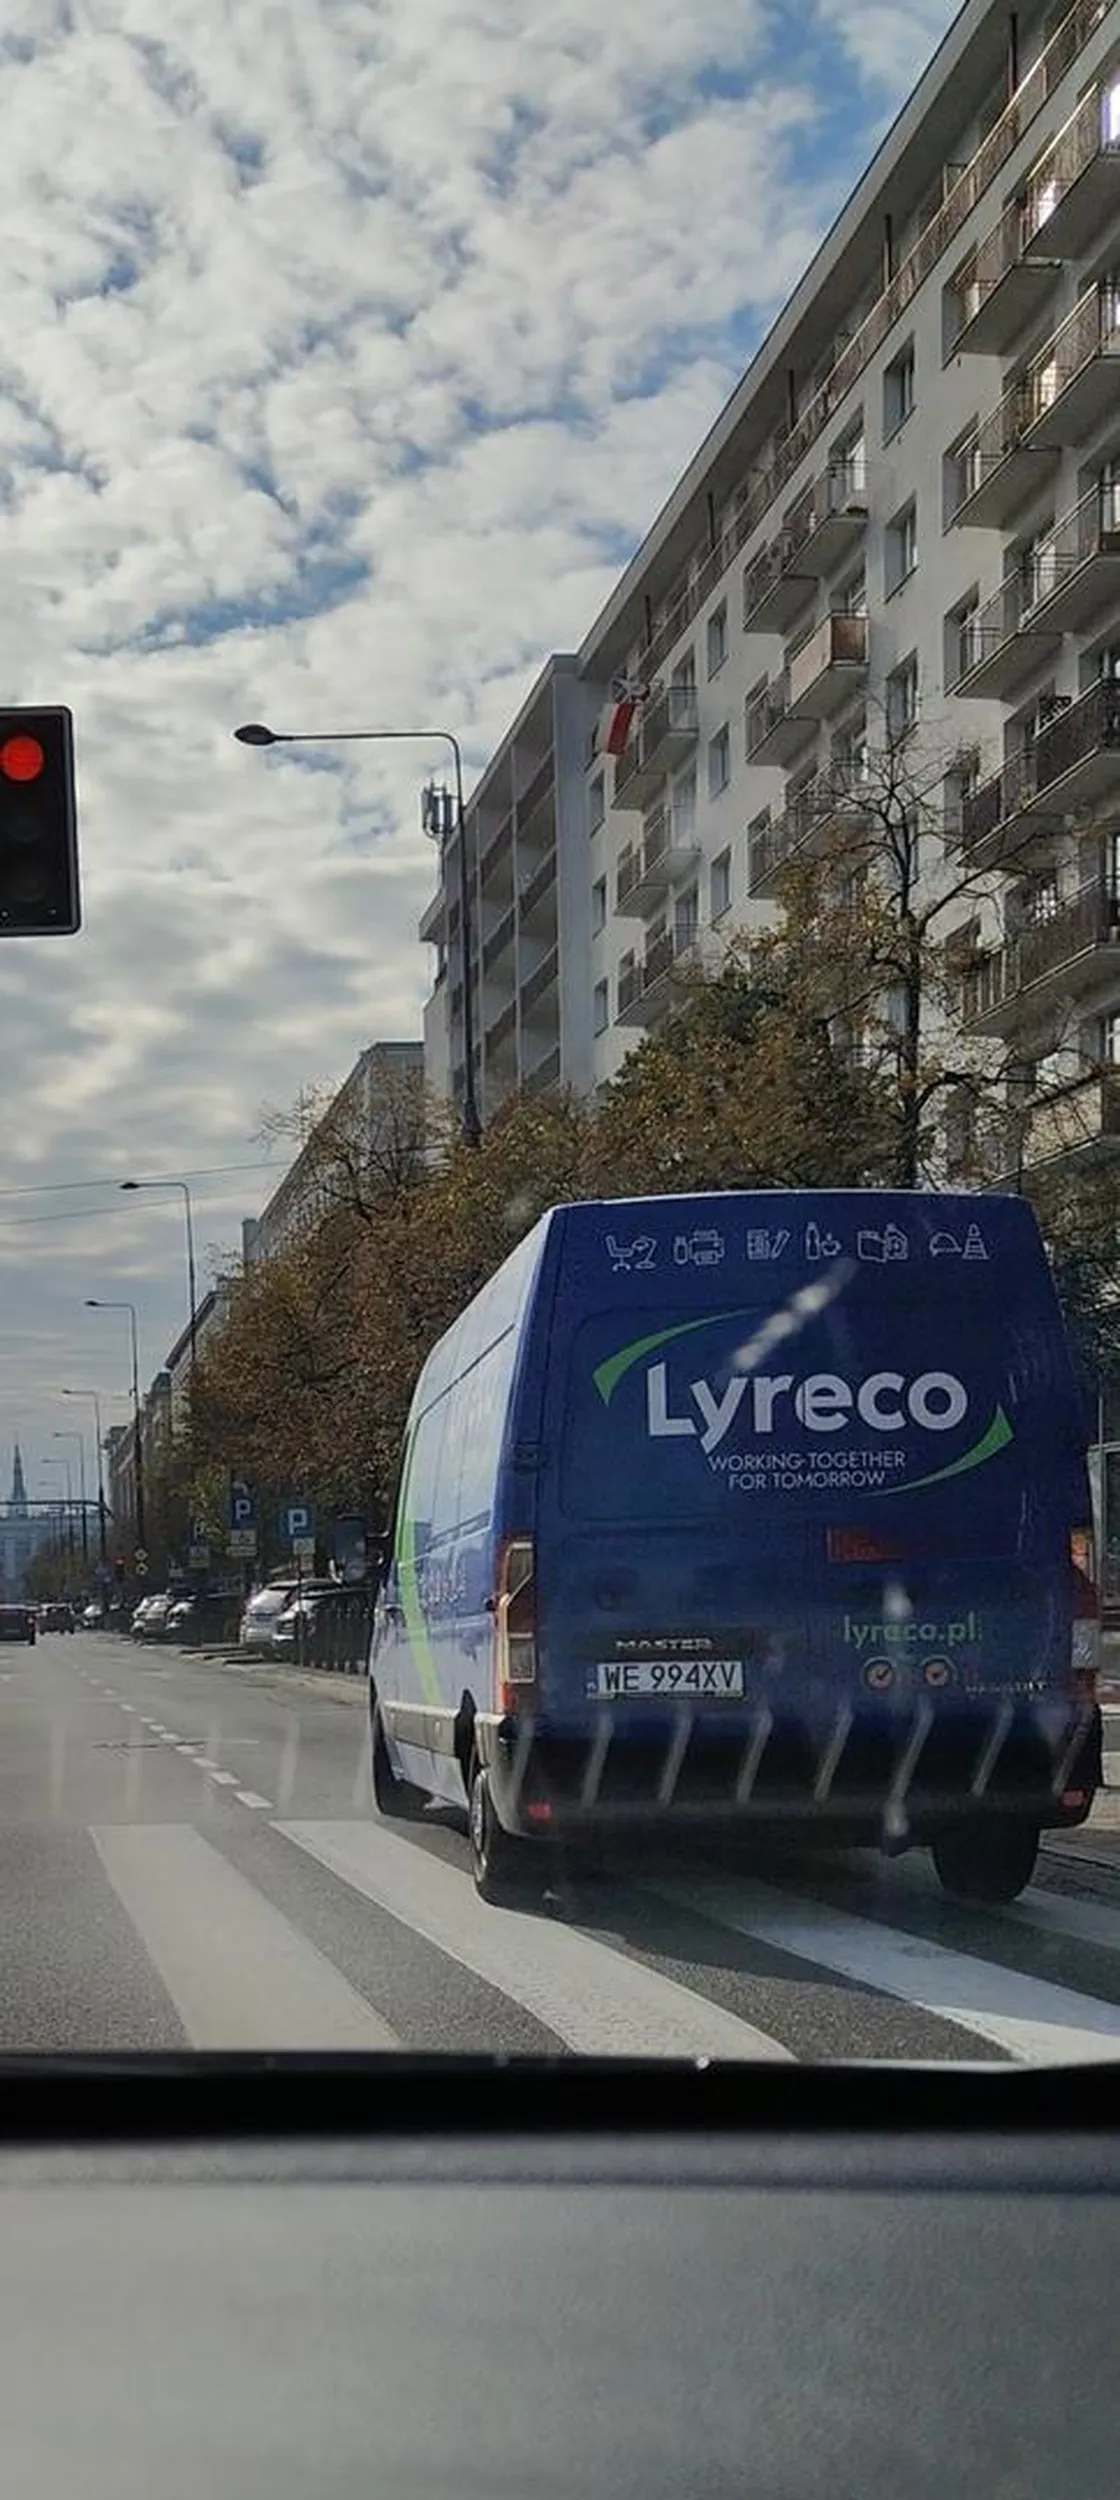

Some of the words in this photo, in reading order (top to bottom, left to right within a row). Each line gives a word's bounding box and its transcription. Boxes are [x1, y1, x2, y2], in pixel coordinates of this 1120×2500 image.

[647, 1361, 968, 1454] Lyreco
[708, 1453, 802, 1471] WORKING
[808, 1451, 905, 1469] TOGETHER
[728, 1473, 767, 1490] FOR
[773, 1471, 886, 1489] TOMORROW
[235, 1499, 251, 1520] P
[288, 1508, 307, 1535] P
[844, 1611, 976, 1649] lyreco.pl
[616, 1638, 712, 1650] MASTER
[604, 1665, 640, 1691] WE
[650, 1663, 736, 1690] 994XV
